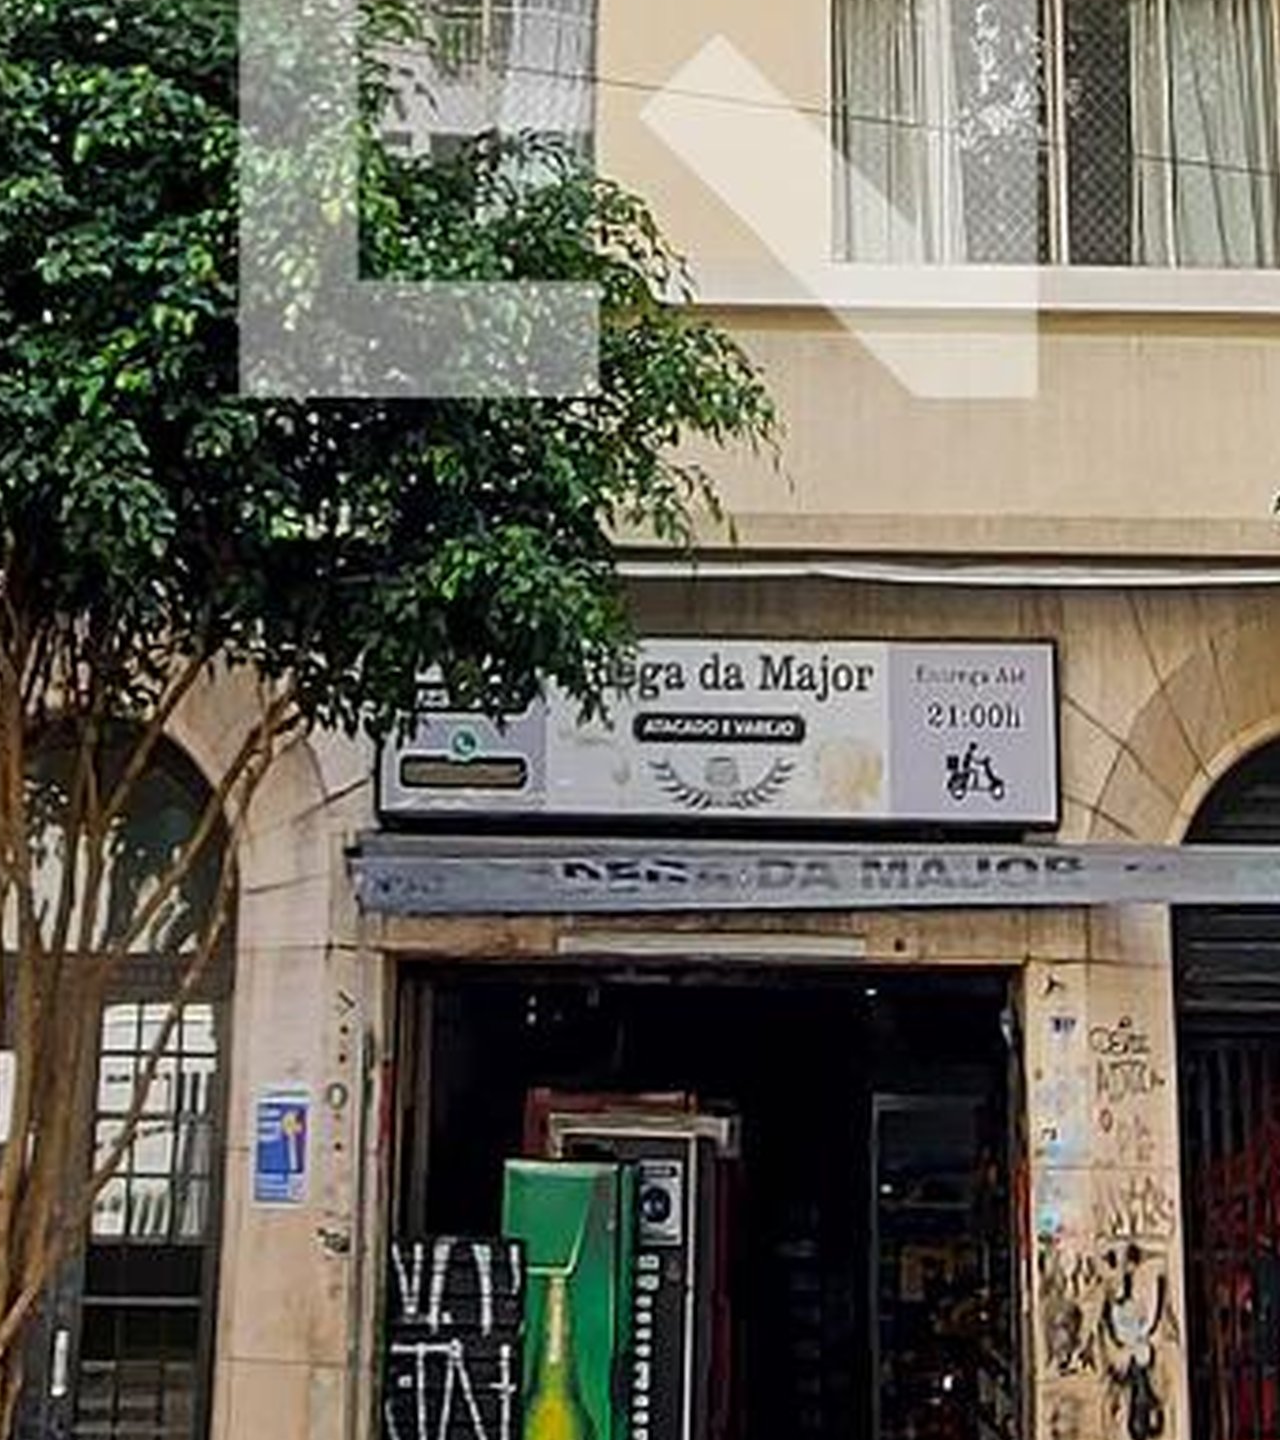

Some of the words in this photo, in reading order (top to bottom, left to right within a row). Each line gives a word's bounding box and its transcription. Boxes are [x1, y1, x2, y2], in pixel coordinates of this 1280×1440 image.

[698, 652, 745, 691] da
[757, 654, 874, 703] Major
[642, 718, 719, 736] ATACADO
[926, 701, 1021, 729] 21:00h
